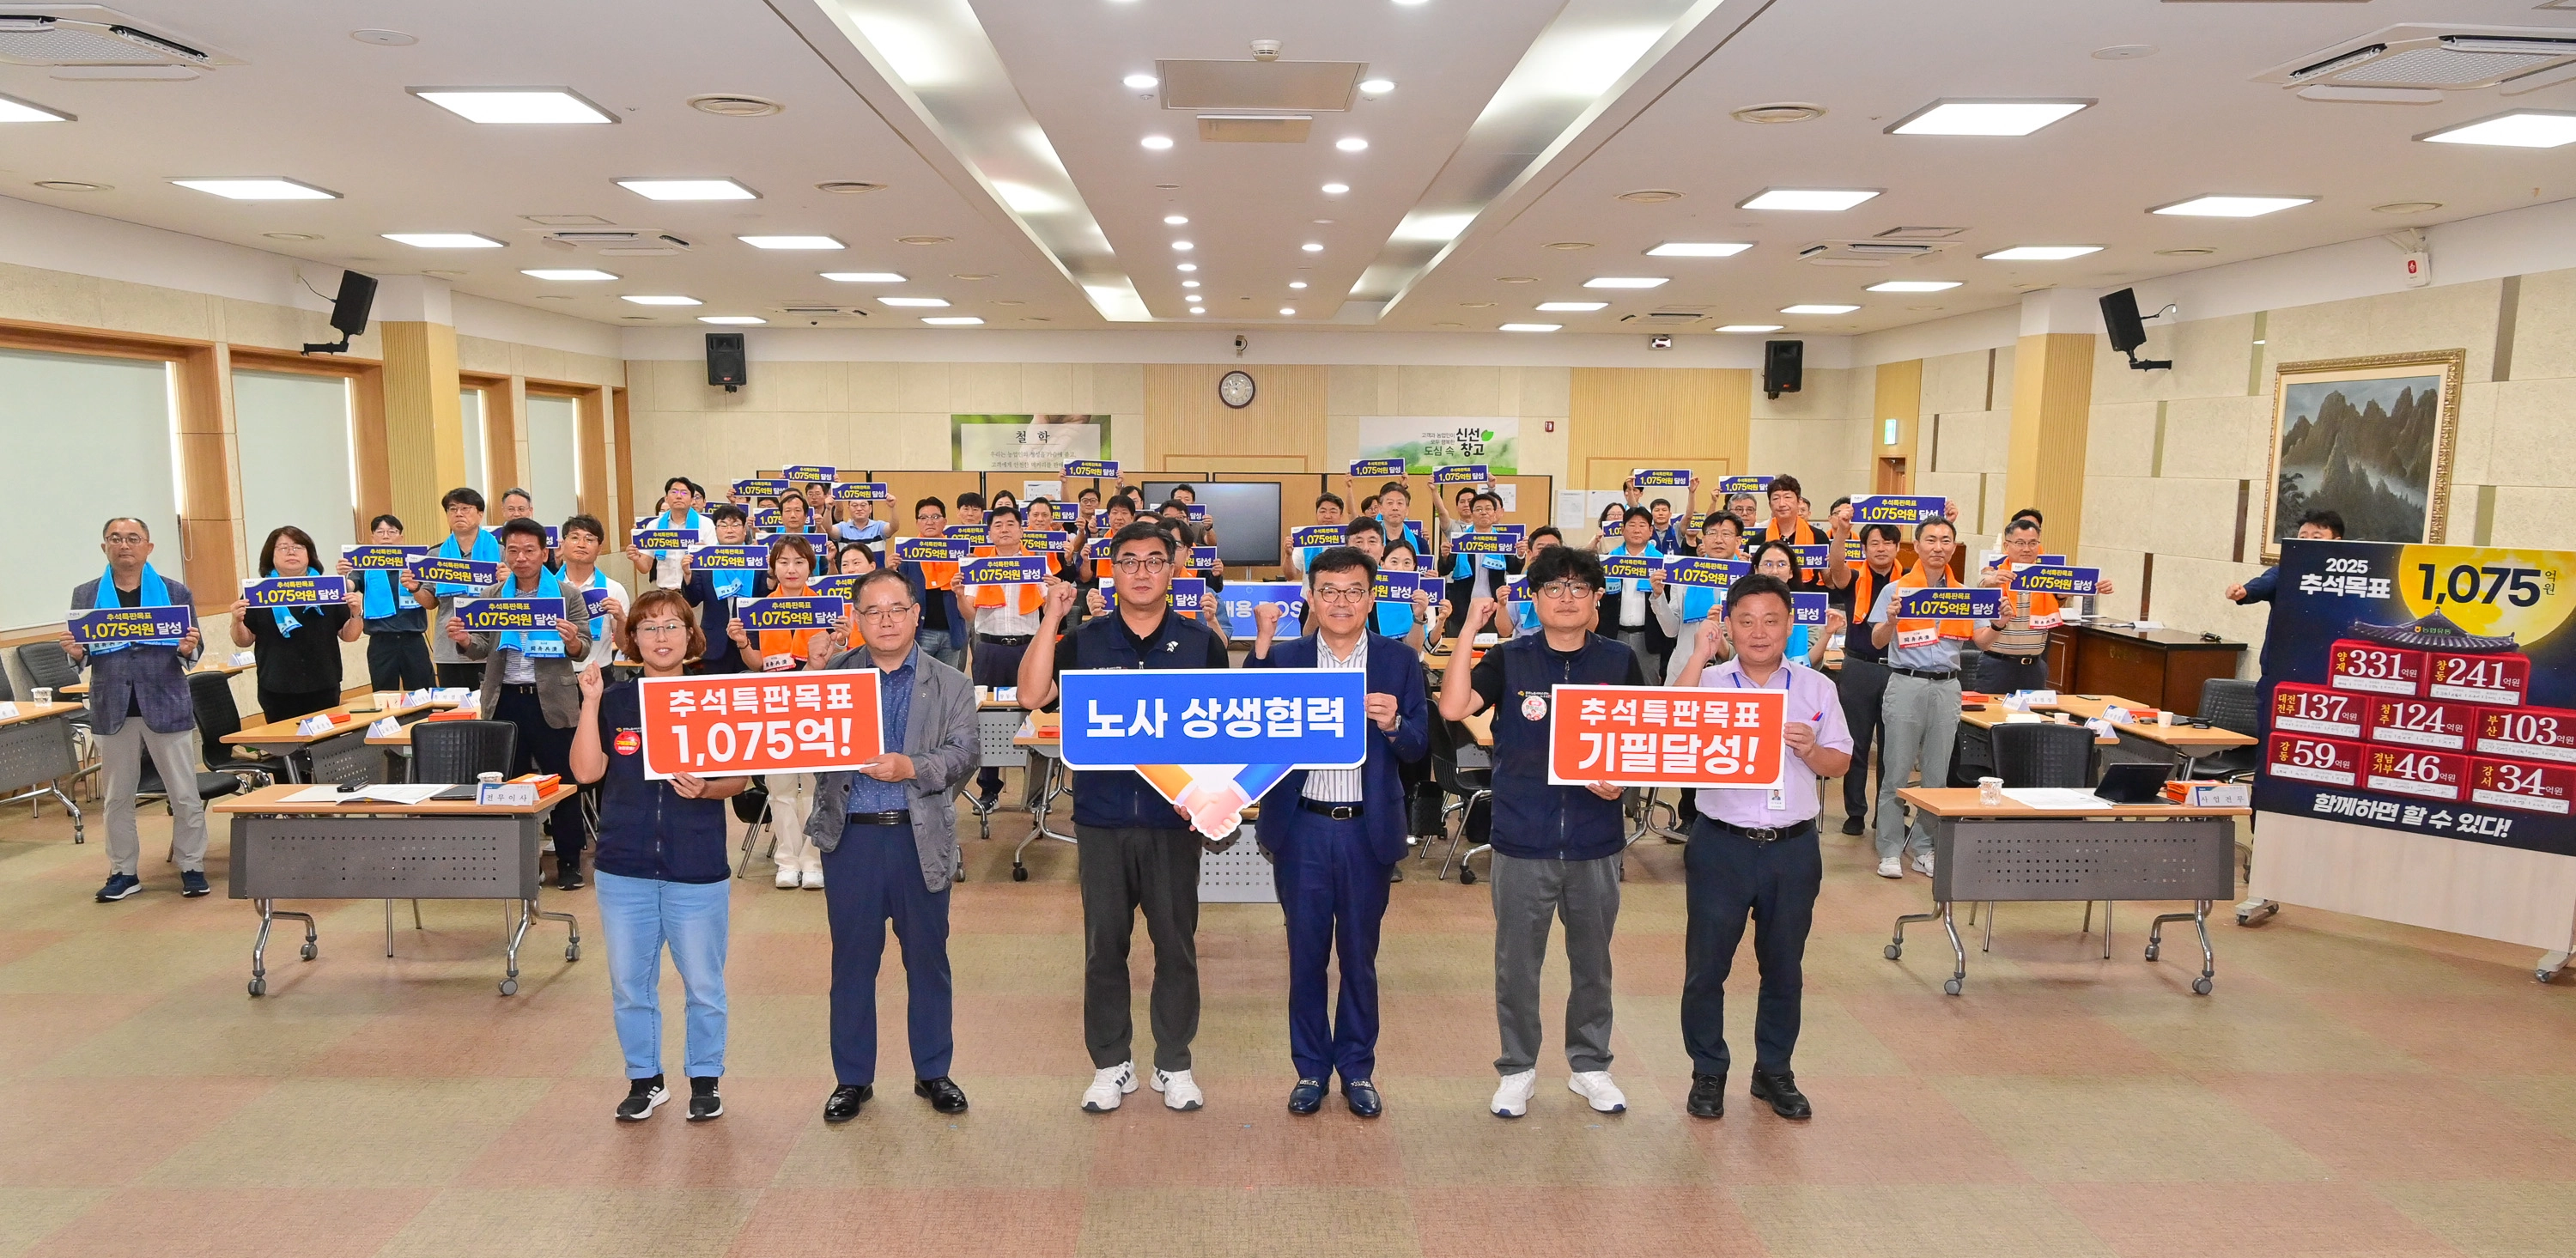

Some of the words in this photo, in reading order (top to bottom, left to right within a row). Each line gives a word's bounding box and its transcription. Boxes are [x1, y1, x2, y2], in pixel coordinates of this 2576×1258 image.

[1456, 428, 1479, 441] 신선
[1424, 446, 1442, 456] 도심
[1445, 447, 1455, 456] 속
[1461, 443, 1485, 457] 창고
[788, 471, 820, 480] 1,075억원
[1355, 466, 1388, 476] 1,075억원
[1389, 465, 1401, 474] 달성
[1439, 472, 1471, 482] 1,075억원
[738, 486, 772, 495] 1,075억원
[1726, 483, 1759, 491] 1,075억원
[838, 489, 871, 499] 1,075억원
[1861, 507, 1917, 520] 1,075억원
[639, 538, 679, 548] 1,075억원
[1299, 534, 1339, 545] 1,075억원
[902, 547, 947, 558] 1,075억원
[948, 550, 965, 558] 달성
[1458, 542, 1498, 551] 1,075억원
[1498, 543, 1513, 551] 달성
[352, 556, 404, 568] 1,075억원
[436, 561, 471, 570] 추석특판목표
[697, 556, 744, 567] 1,075억원
[746, 556, 762, 566] 달성
[1195, 558, 1212, 567] 달성
[1693, 562, 1728, 570] 추석특판목표
[1806, 556, 1822, 566] 달성
[2325, 558, 2368, 574] 2025
[418, 567, 471, 582] 1,075억원
[473, 573, 493, 583] 달성
[969, 569, 1020, 582] 1,075억원
[1023, 570, 1041, 580] 달성
[1603, 565, 1647, 576] 1,075억원
[1673, 569, 1728, 585] 1,075억원
[2021, 575, 2072, 590] 1,075억원
[2074, 580, 2092, 591] 달성
[2300, 574, 2391, 599] 추석목표
[2418, 563, 2542, 607] 1,075
[256, 589, 316, 605] 1,075억원
[318, 589, 339, 600] 달성
[1390, 586, 1412, 599] 달성
[772, 601, 811, 610] 추석특판목표
[1176, 593, 1197, 607] 달성
[1797, 608, 1819, 621] 달성
[1910, 601, 1970, 616] 1,075억원
[1972, 603, 1994, 615] 달성
[106, 612, 152, 621] 추석특판목표
[465, 611, 532, 628] 1,075억원
[534, 613, 557, 626] 달성
[750, 611, 812, 627] 1,075억원
[815, 612, 838, 623] 달성
[82, 623, 155, 640] 1,075억원
[156, 622, 182, 635] 달성
[669, 684, 854, 718] 추석특판목표
[2278, 694, 2296, 704] 대전
[1579, 698, 1760, 728] 추석특판목표
[2277, 704, 2295, 714] 전주
[1085, 698, 1168, 738] 노사
[1182, 697, 1345, 738] 상생협력
[669, 718, 852, 768] 1,075억!
[1578, 732, 1759, 775] 기필달성!
[2373, 752, 2394, 763] 경남
[2372, 763, 2392, 774] 기부
[2313, 793, 2400, 822] 함께하면
[2402, 805, 2427, 826] 할
[2428, 810, 2452, 830] 수
[2457, 813, 2512, 838] 있다!
